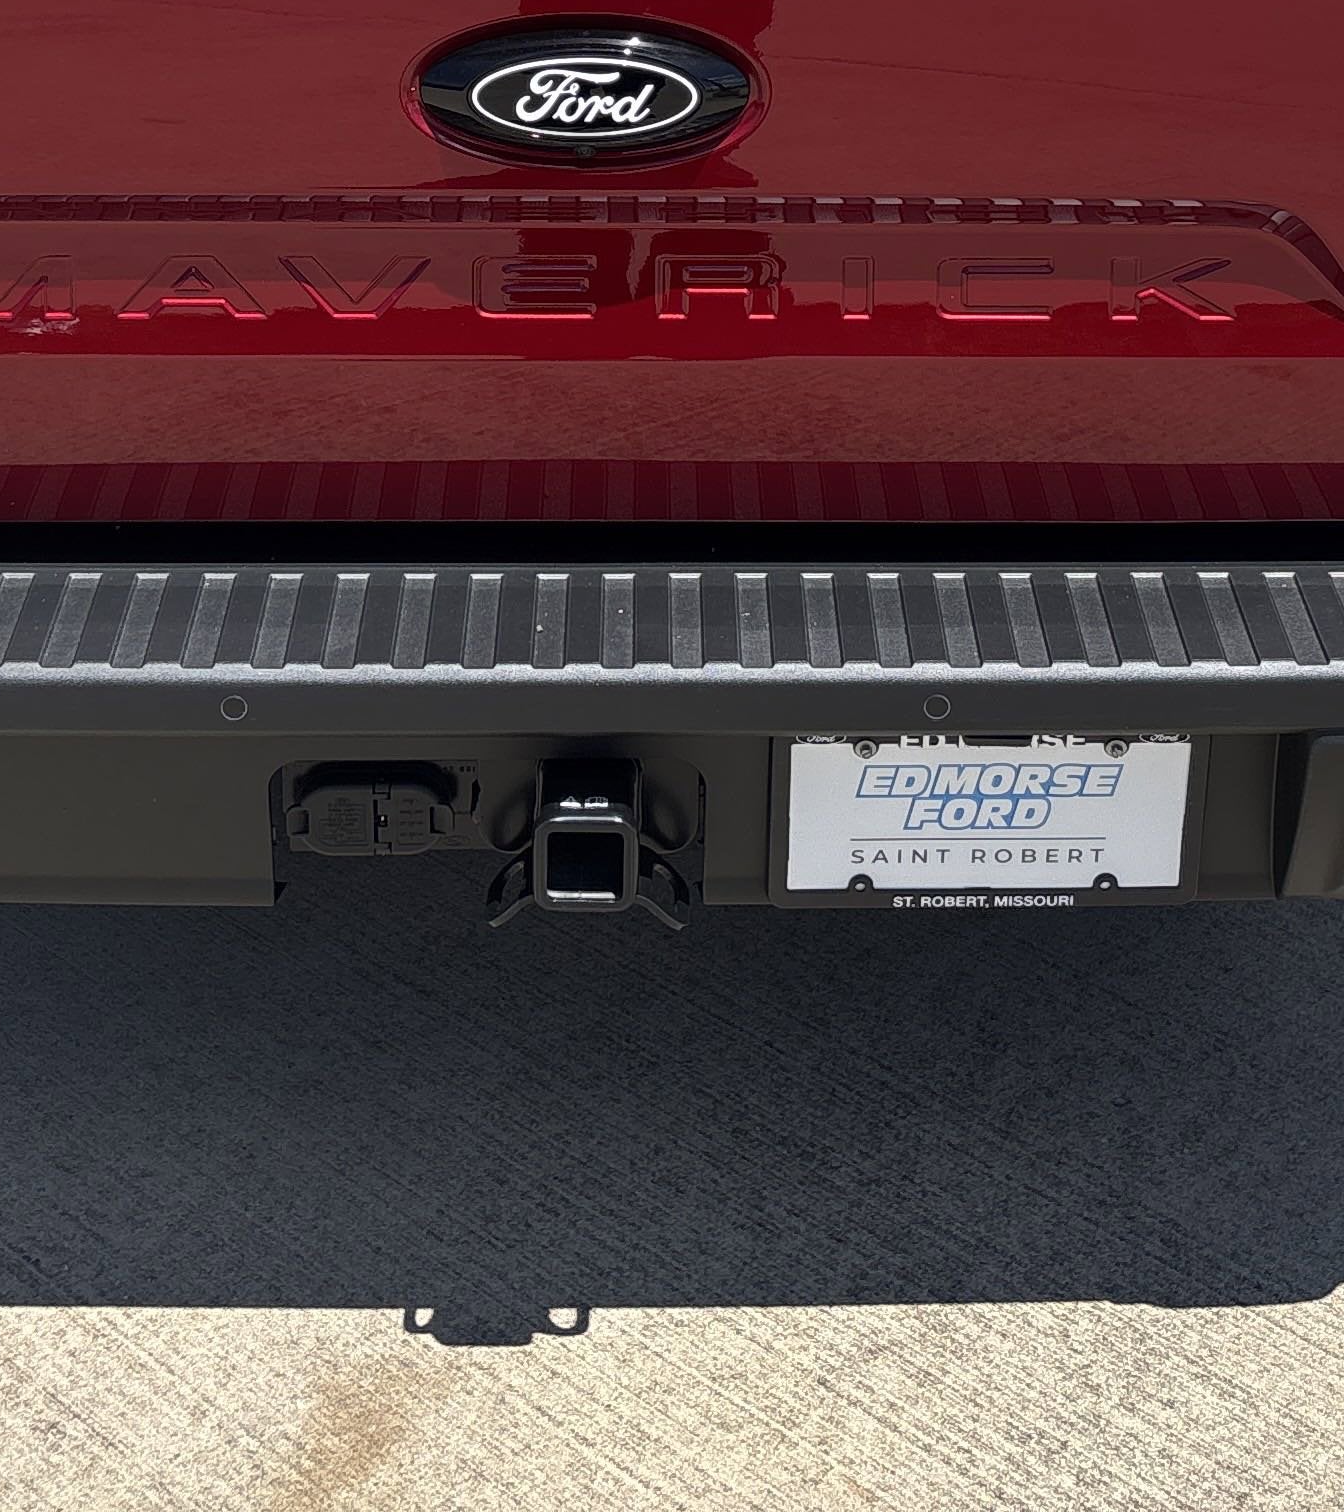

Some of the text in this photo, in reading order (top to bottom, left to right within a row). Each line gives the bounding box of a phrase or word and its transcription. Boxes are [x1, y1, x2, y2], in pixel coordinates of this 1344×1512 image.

[516, 69, 655, 124] Ford
[856, 763, 1124, 798] ED MORSE
[903, 797, 1052, 830] FORD
[851, 848, 1105, 864] SAINT ROBERT
[892, 894, 1074, 909] ST. ROBERT, MISSOURI
